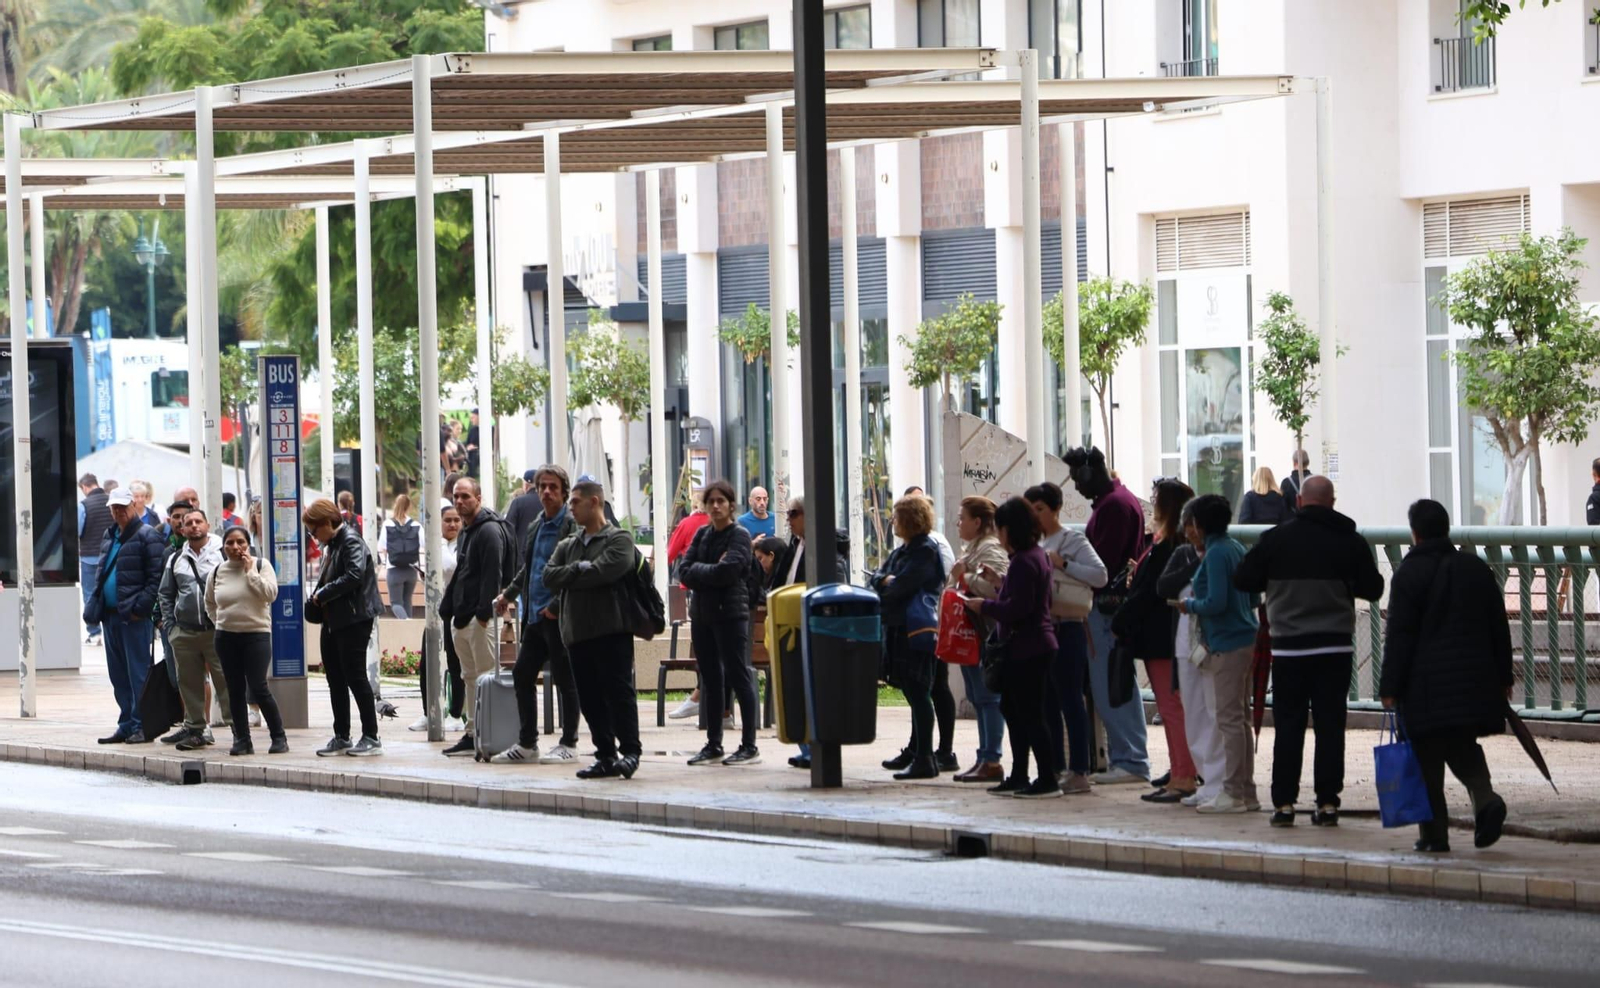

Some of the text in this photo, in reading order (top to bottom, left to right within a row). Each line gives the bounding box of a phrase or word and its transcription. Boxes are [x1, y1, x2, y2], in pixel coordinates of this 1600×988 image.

[268, 363, 295, 384] BUS
[279, 409, 288, 423] 3
[275, 424, 290, 438] 11
[280, 439, 288, 453] 8
